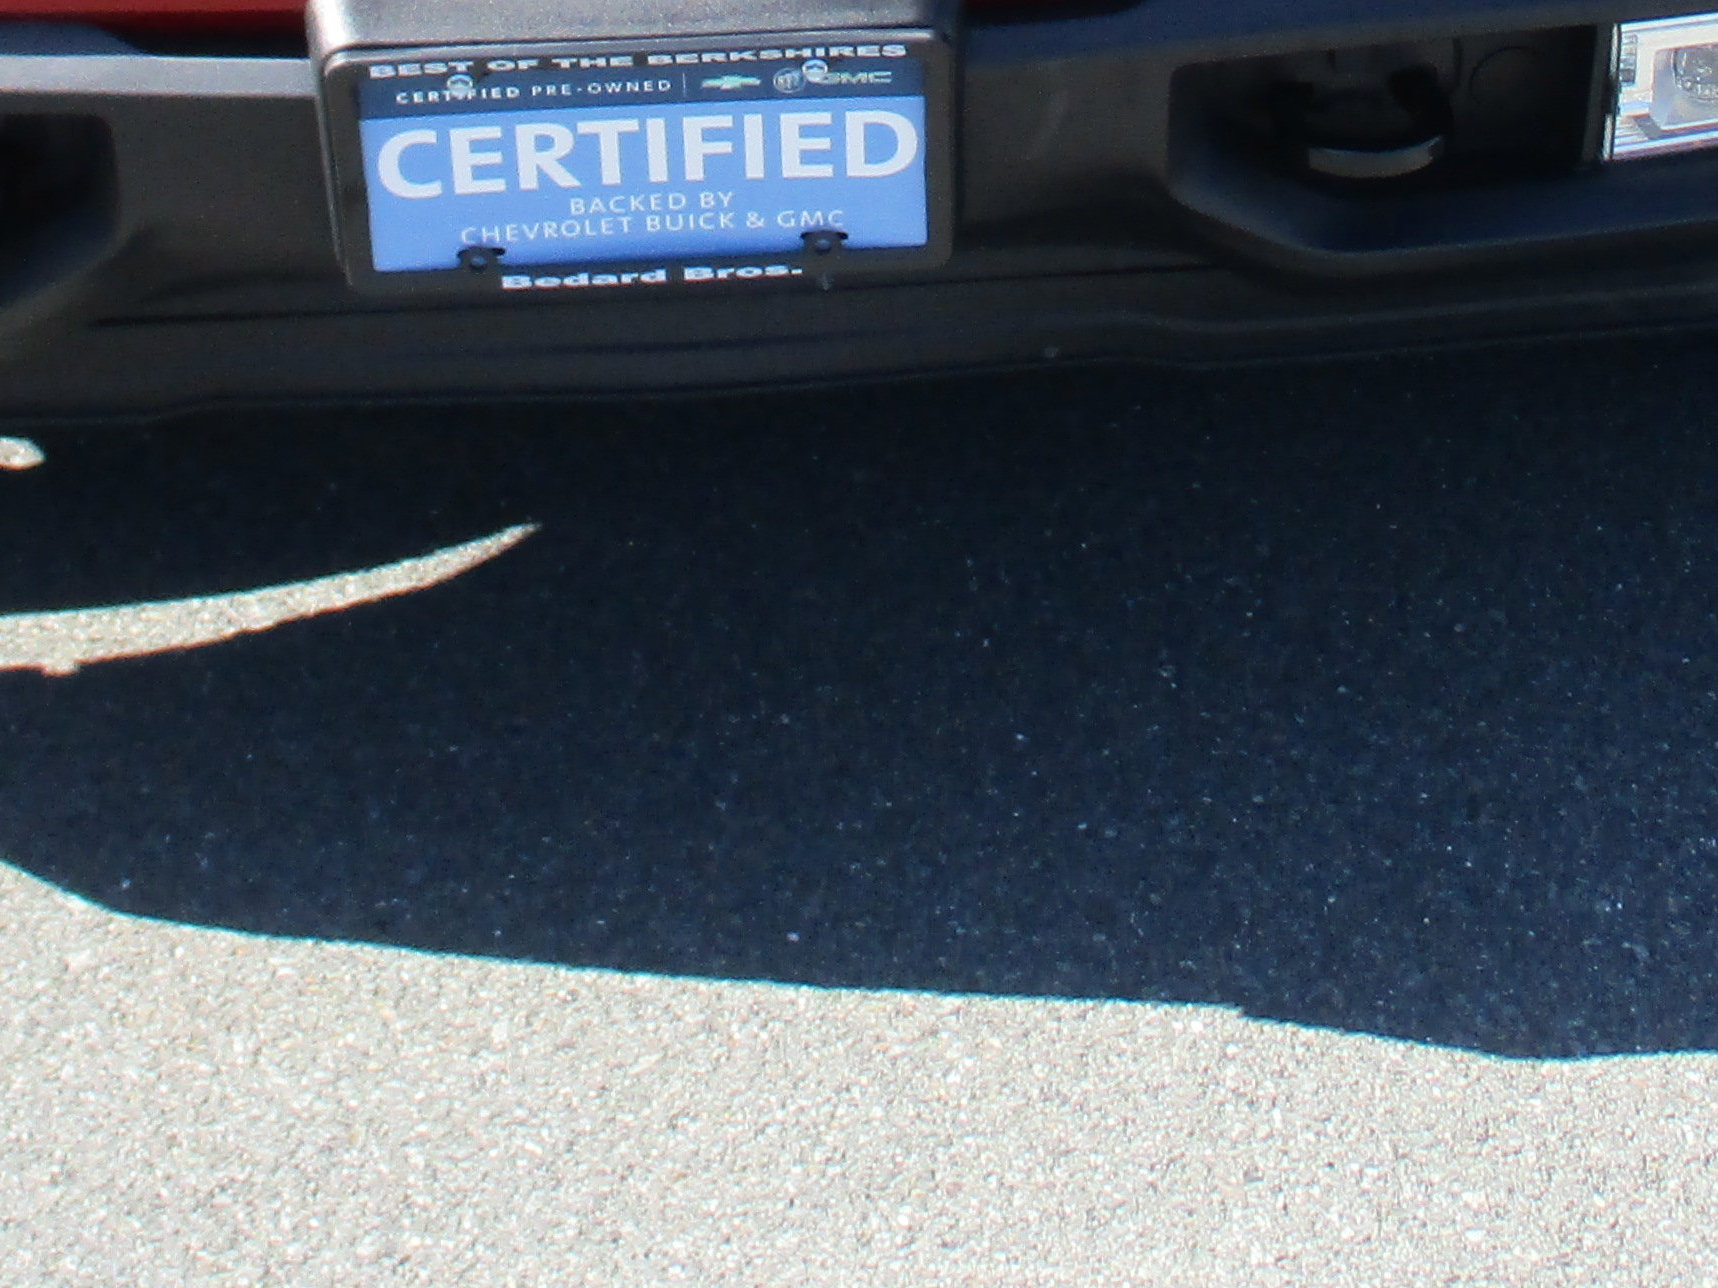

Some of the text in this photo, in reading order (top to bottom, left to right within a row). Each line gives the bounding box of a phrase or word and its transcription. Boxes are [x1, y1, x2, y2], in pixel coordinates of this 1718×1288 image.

[370, 44, 908, 79] BEST OF THE BERKSHIRES
[395, 80, 671, 105] CERTFIED PRE-OWNED
[377, 110, 918, 200] CERTIFIED
[569, 190, 736, 217] BACKED BY
[460, 209, 845, 245] CHEVROLET BUICK & GMC
[501, 264, 804, 291] Bedard Bros.
